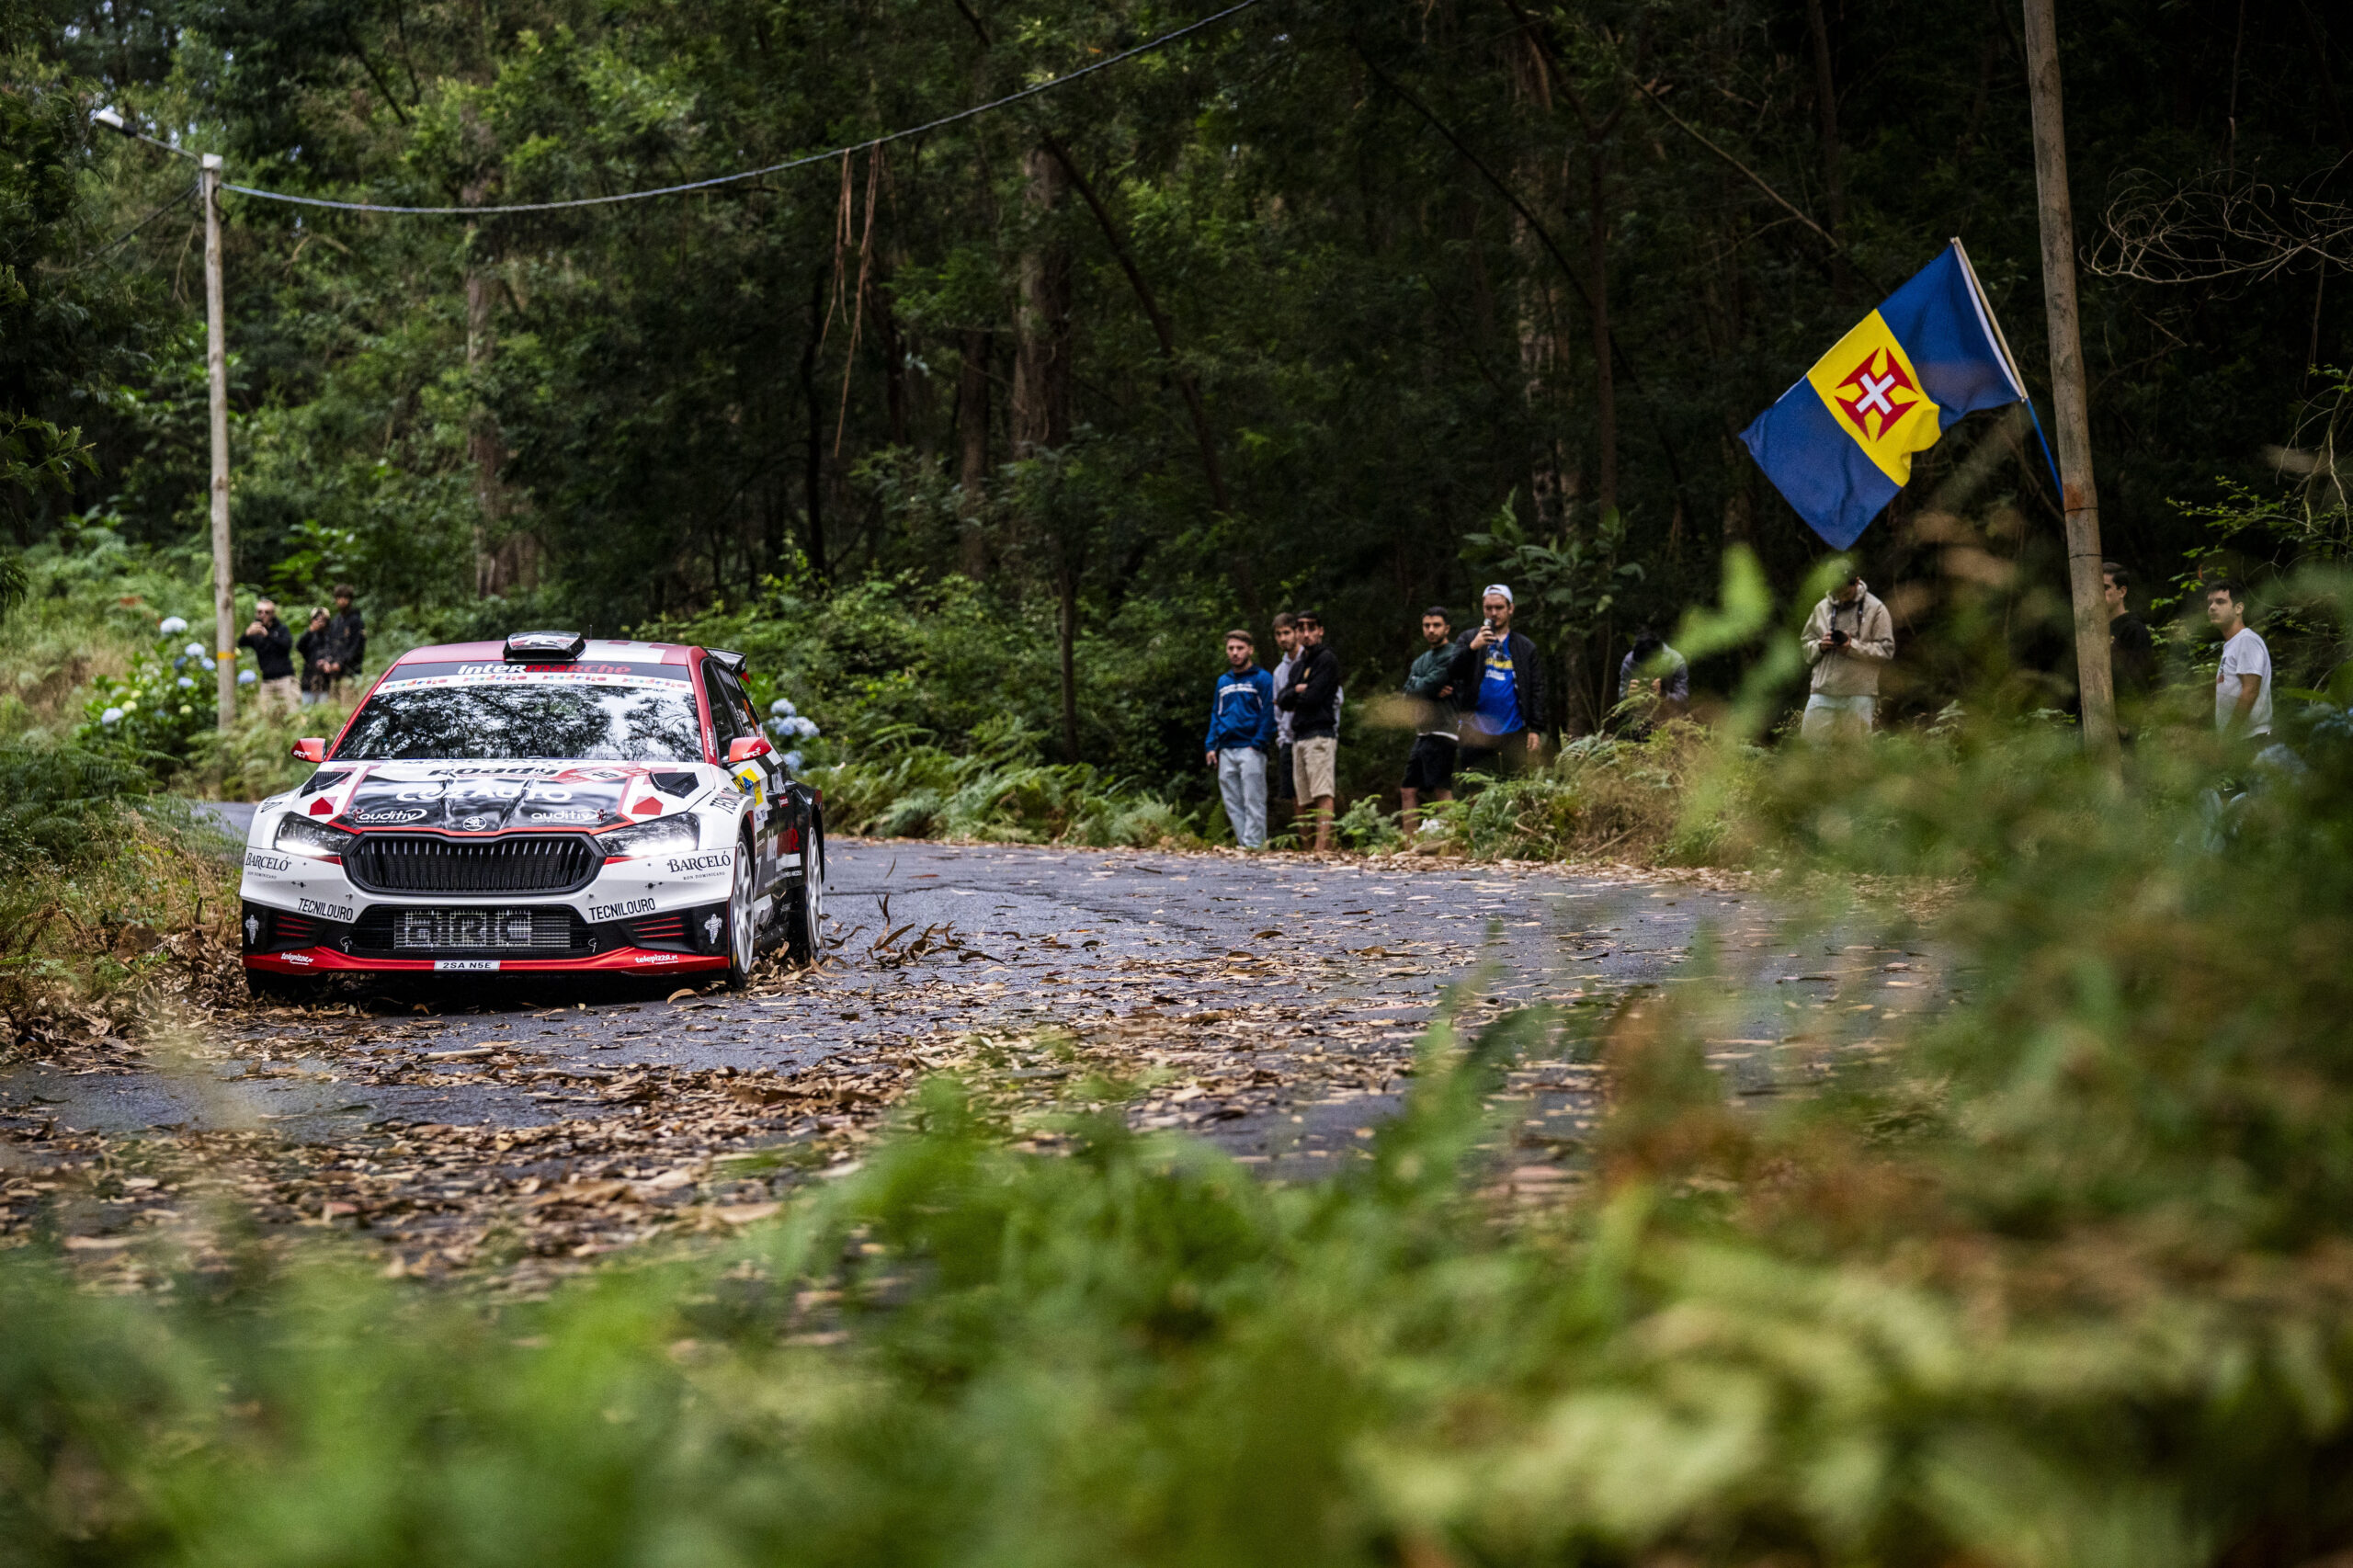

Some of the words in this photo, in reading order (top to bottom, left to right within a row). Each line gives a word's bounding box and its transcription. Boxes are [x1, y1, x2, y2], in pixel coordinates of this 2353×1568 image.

[358, 809, 423, 820] auditiv
[531, 810, 595, 821] auditiv
[245, 852, 290, 872] BARCELÓ
[669, 850, 732, 872] BARCELÓ
[298, 898, 354, 921] TECNILOURO
[589, 897, 656, 921] TECNILOURO
